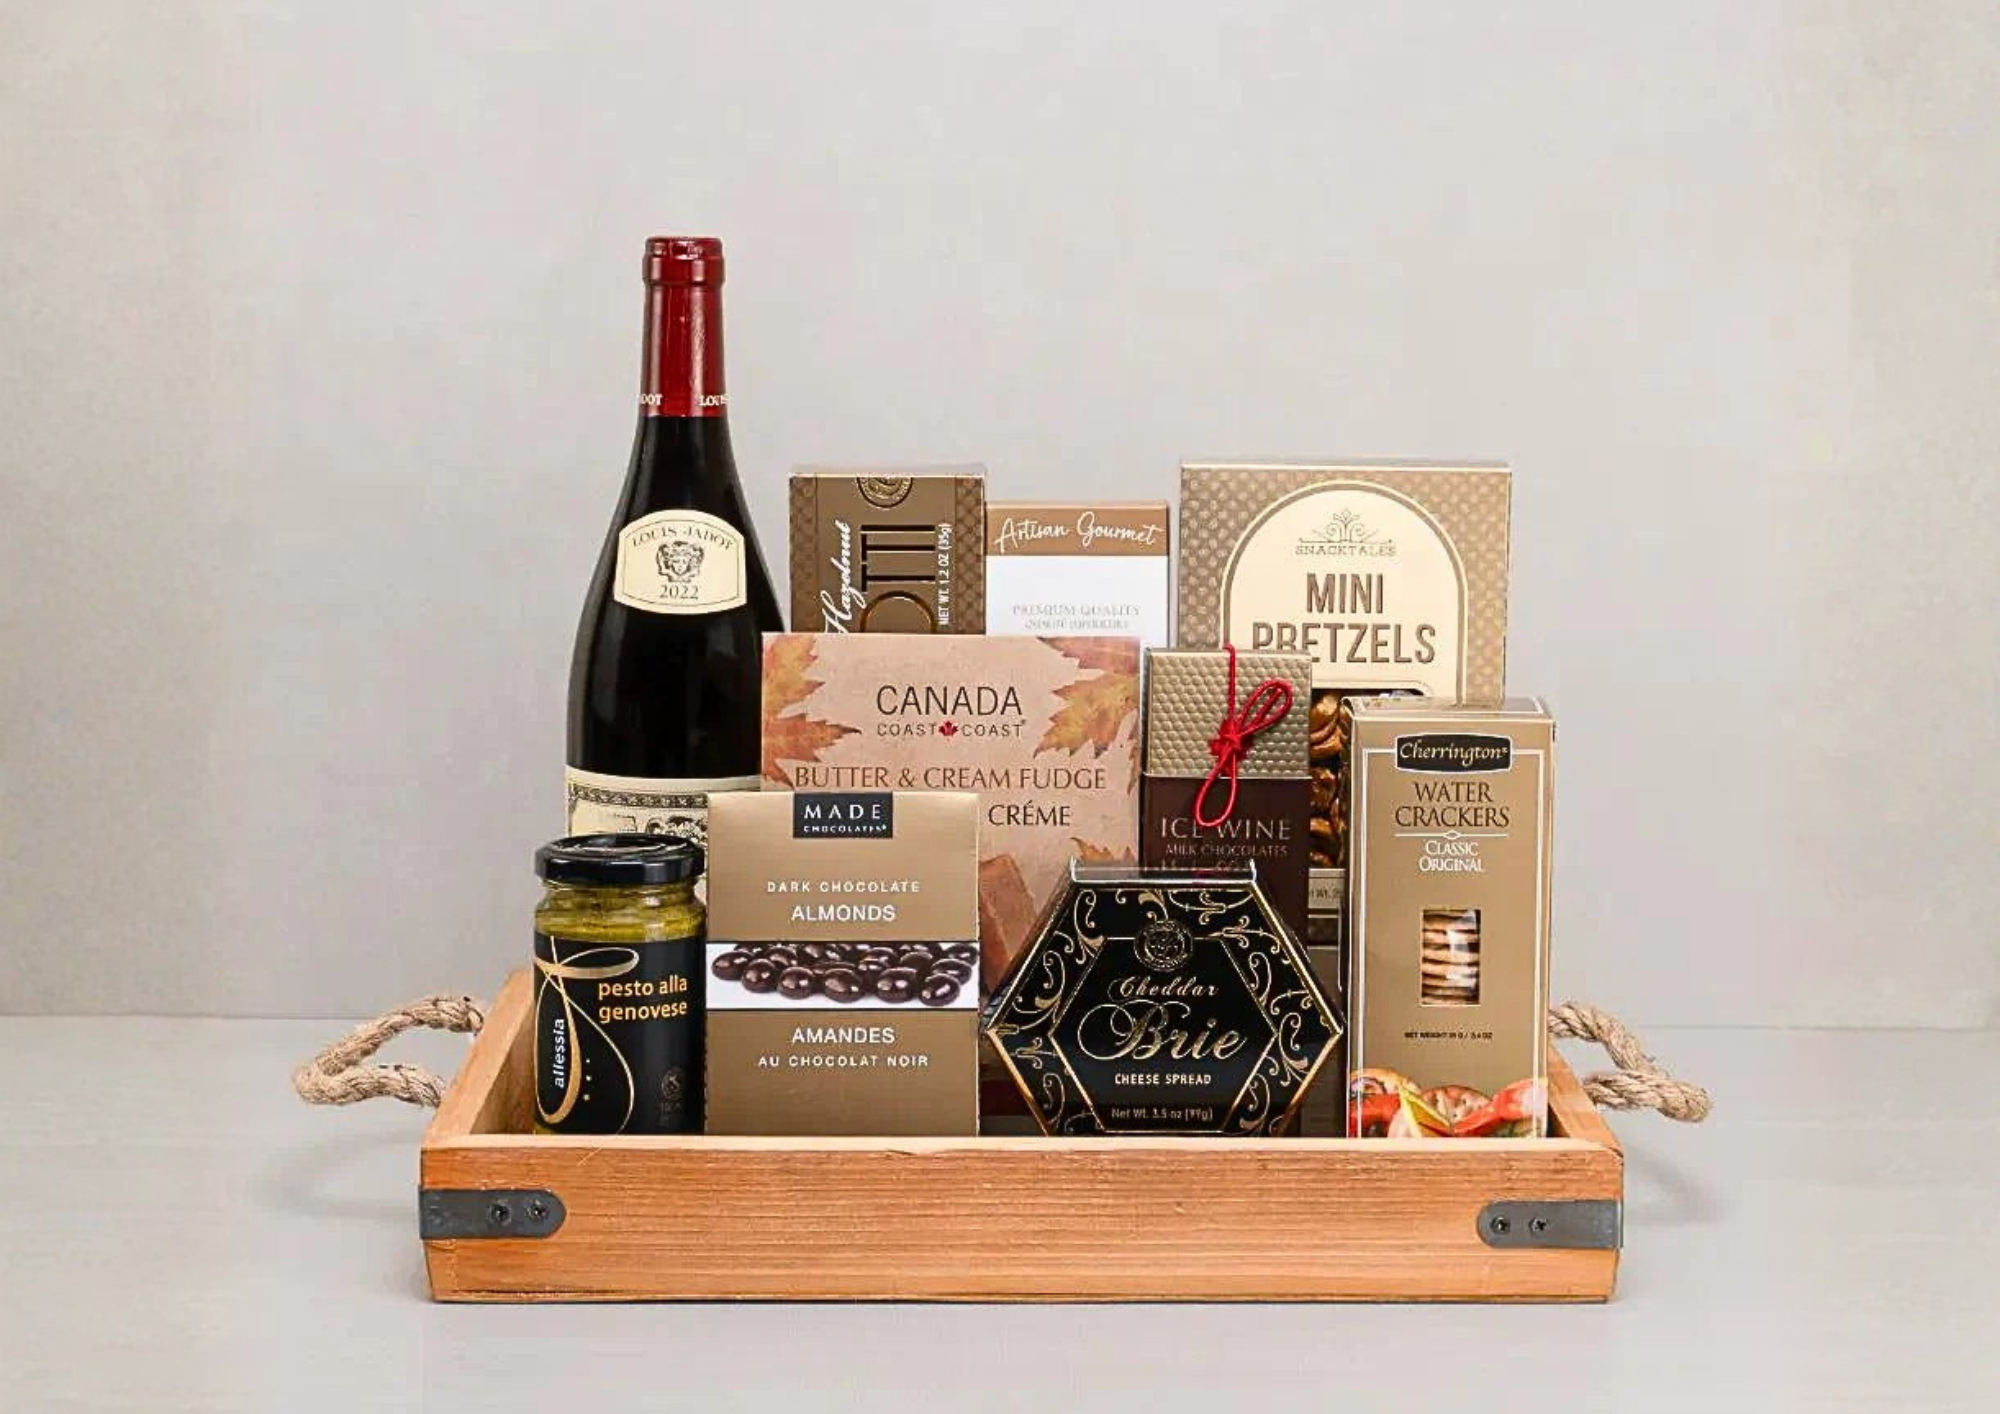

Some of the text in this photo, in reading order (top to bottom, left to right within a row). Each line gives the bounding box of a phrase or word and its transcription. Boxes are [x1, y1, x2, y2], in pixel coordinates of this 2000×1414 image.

[632, 526, 734, 550] LOUIS JADOT
[994, 511, 1168, 554] Artisan Gourmet
[937, 553, 950, 566] OZ
[859, 524, 938, 633] OTTI
[937, 568, 950, 584] 1.2
[659, 585, 700, 600] 2022
[1306, 573, 1384, 614] MINI
[937, 606, 950, 625] NET
[1252, 622, 1436, 664] PRETZELS
[876, 685, 1023, 716] CANADA
[877, 723, 937, 737] COAST
[1400, 740, 1501, 767] Cherrington
[794, 766, 1107, 790] BUTTER & CREAM FUDGE
[1414, 781, 1493, 802] WATER
[803, 803, 882, 820] MADE
[1395, 805, 1511, 828] CRACKERS
[1216, 818, 1293, 841] WINE
[1165, 843, 1289, 857] MILK CHOCOLATES
[1425, 840, 1479, 857] CLASSIC
[1418, 856, 1483, 873] ORIGINAL
[767, 881, 920, 893] DARK CHOCOLATE
[791, 904, 896, 922] ALMONDS
[598, 975, 688, 1001] pesto alla
[1108, 975, 1220, 999] Cheddar
[598, 1000, 688, 1024] genovese
[791, 1026, 896, 1044] AMANDES
[1077, 999, 1248, 1061] Brie
[552, 1018, 566, 1089] allessia
[758, 1055, 929, 1067] AU CHOCOLAT NOIR
[1114, 1072, 1212, 1086] CHEESE SPREAD
[1111, 1107, 1129, 1119] Net
